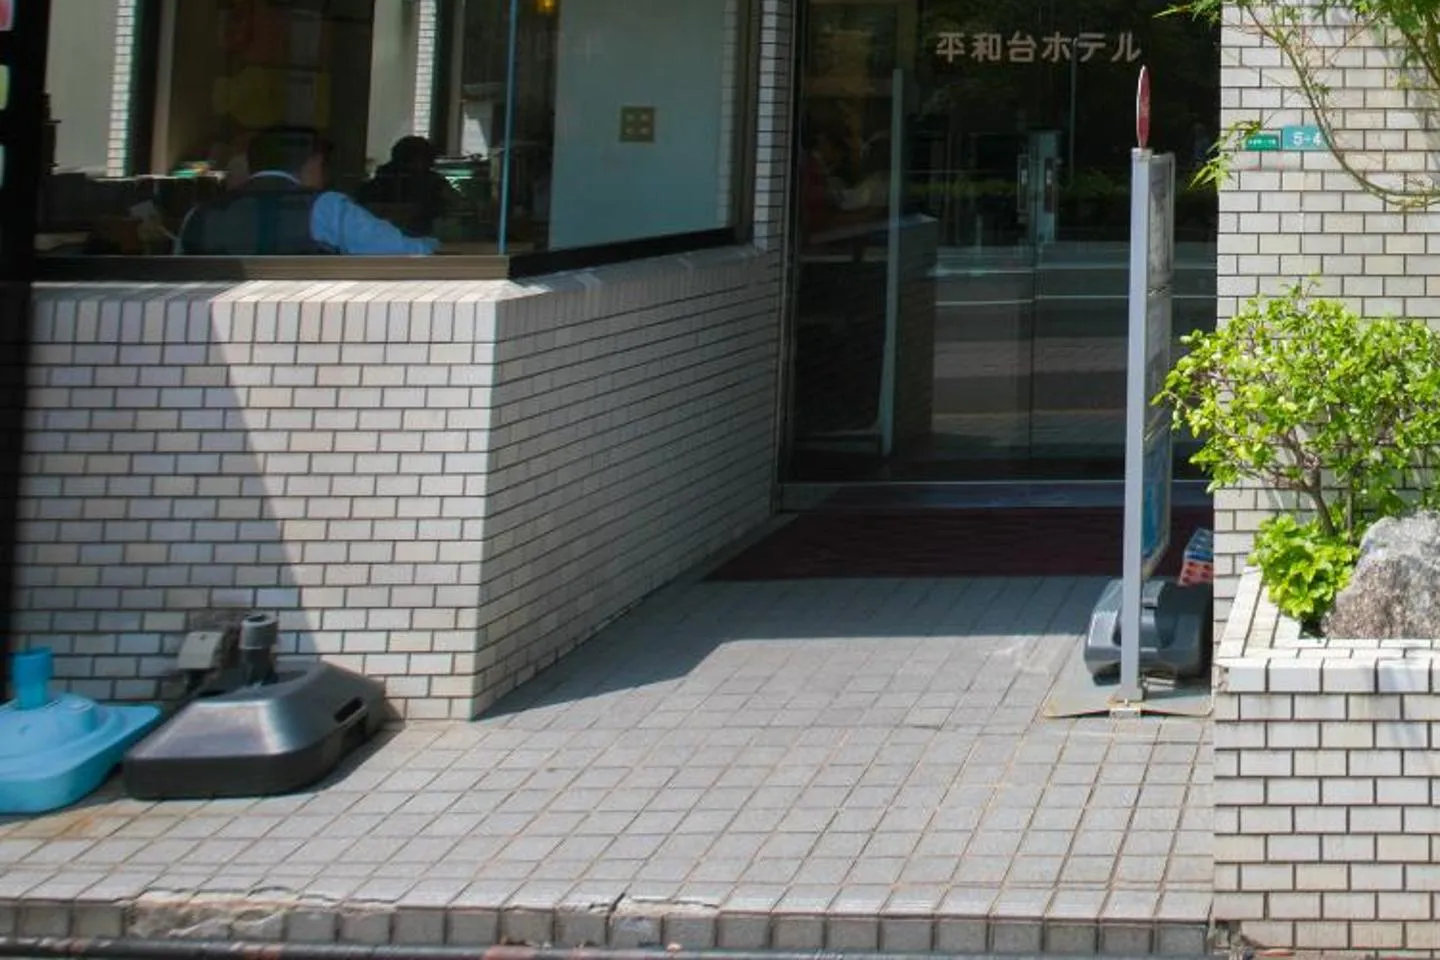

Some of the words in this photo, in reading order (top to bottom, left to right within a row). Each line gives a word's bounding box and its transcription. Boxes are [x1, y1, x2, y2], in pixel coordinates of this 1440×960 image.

[934, 29, 1142, 64] 平和台ホテル
